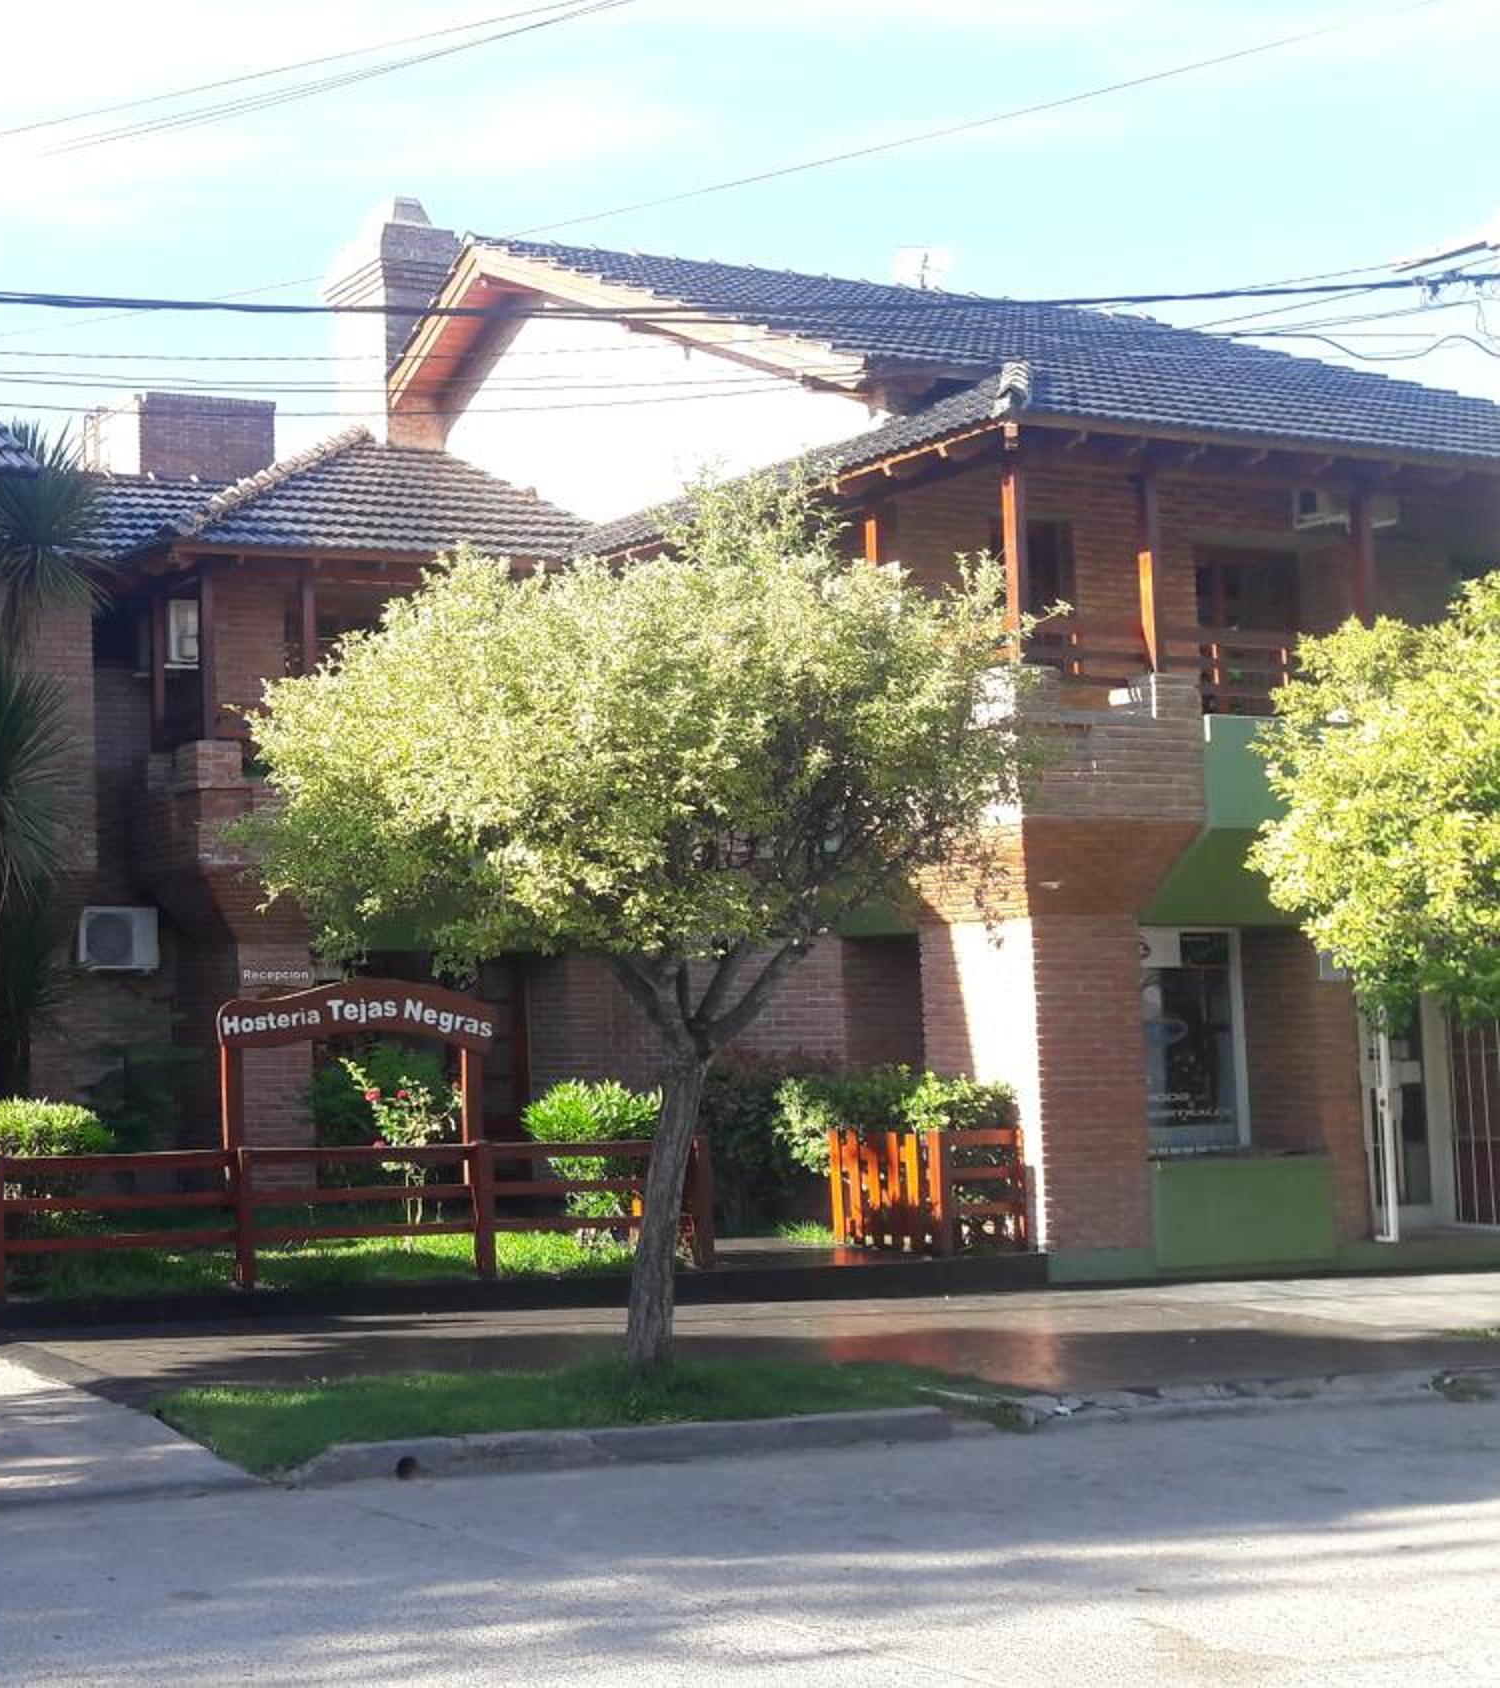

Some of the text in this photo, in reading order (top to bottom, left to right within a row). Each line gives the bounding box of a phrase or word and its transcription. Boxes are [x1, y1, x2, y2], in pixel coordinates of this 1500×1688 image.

[243, 969, 309, 981] Recepcion
[222, 998, 493, 1037] Hosteria Tejas Negras
